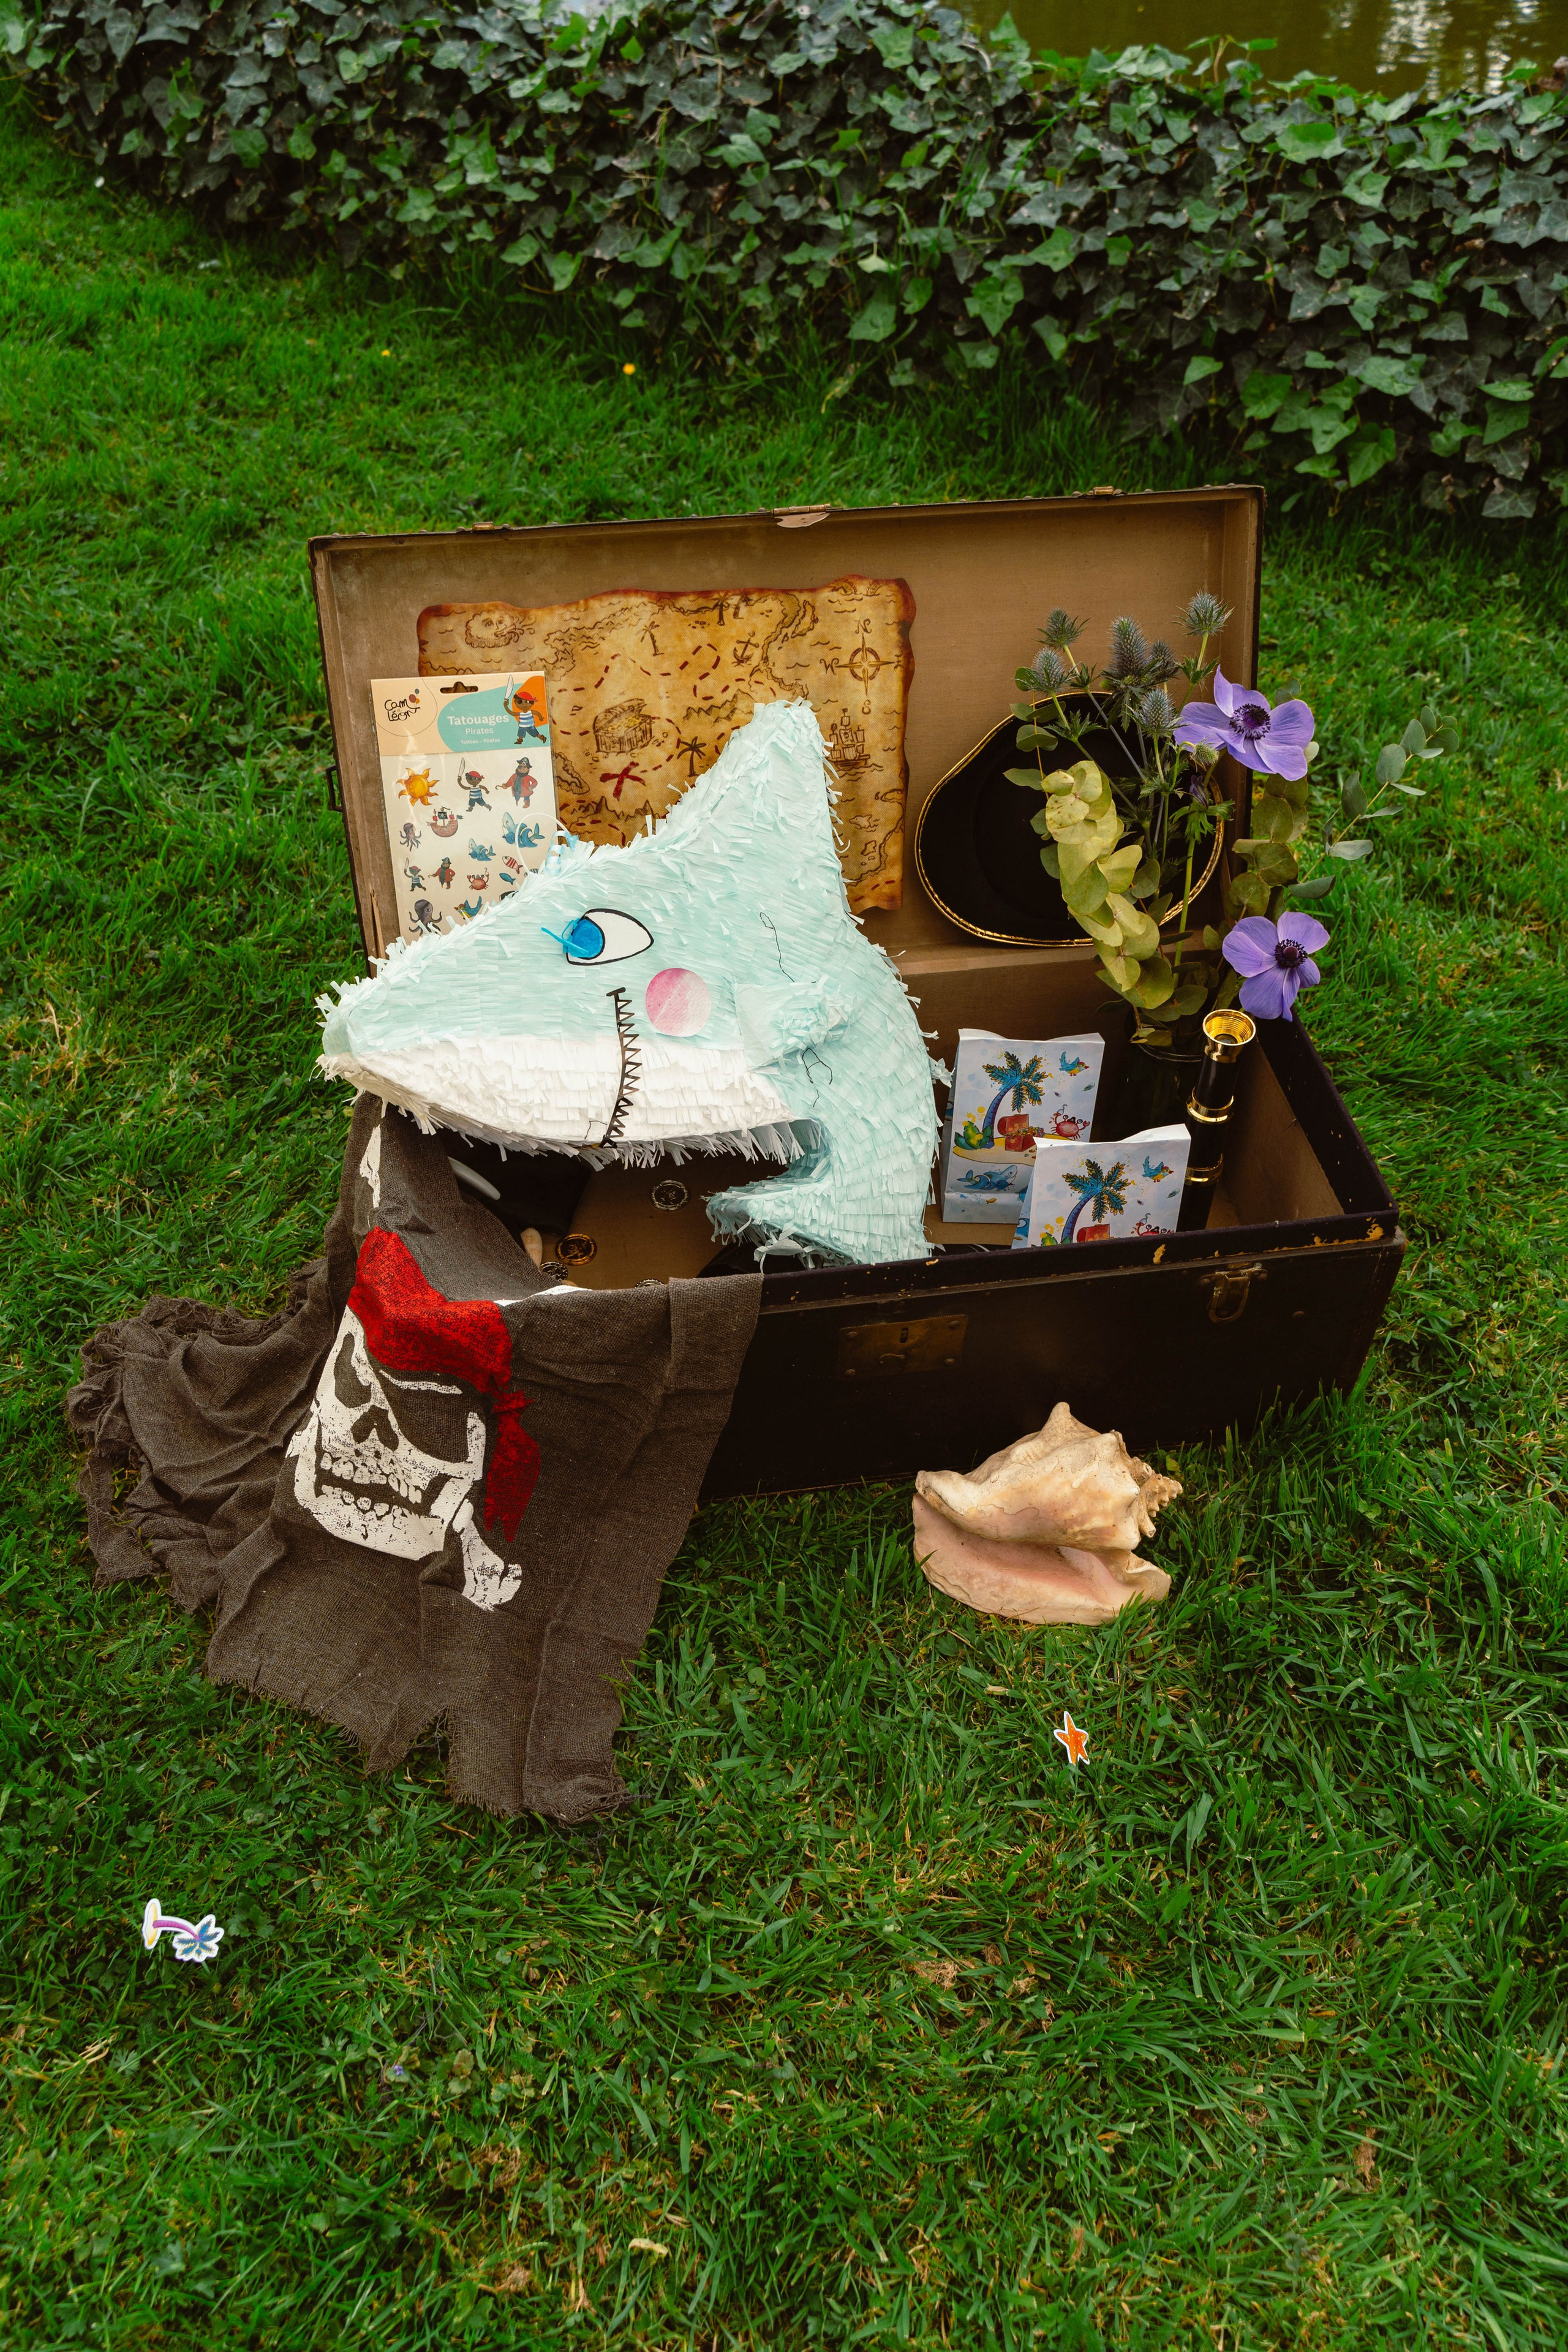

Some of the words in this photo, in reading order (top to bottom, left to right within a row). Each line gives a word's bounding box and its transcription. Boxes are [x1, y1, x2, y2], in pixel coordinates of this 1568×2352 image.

[854, 618, 872, 634] N
[820, 658, 839, 675] W
[384, 698, 421, 711] Cam
[447, 714, 510, 726] Tatouages
